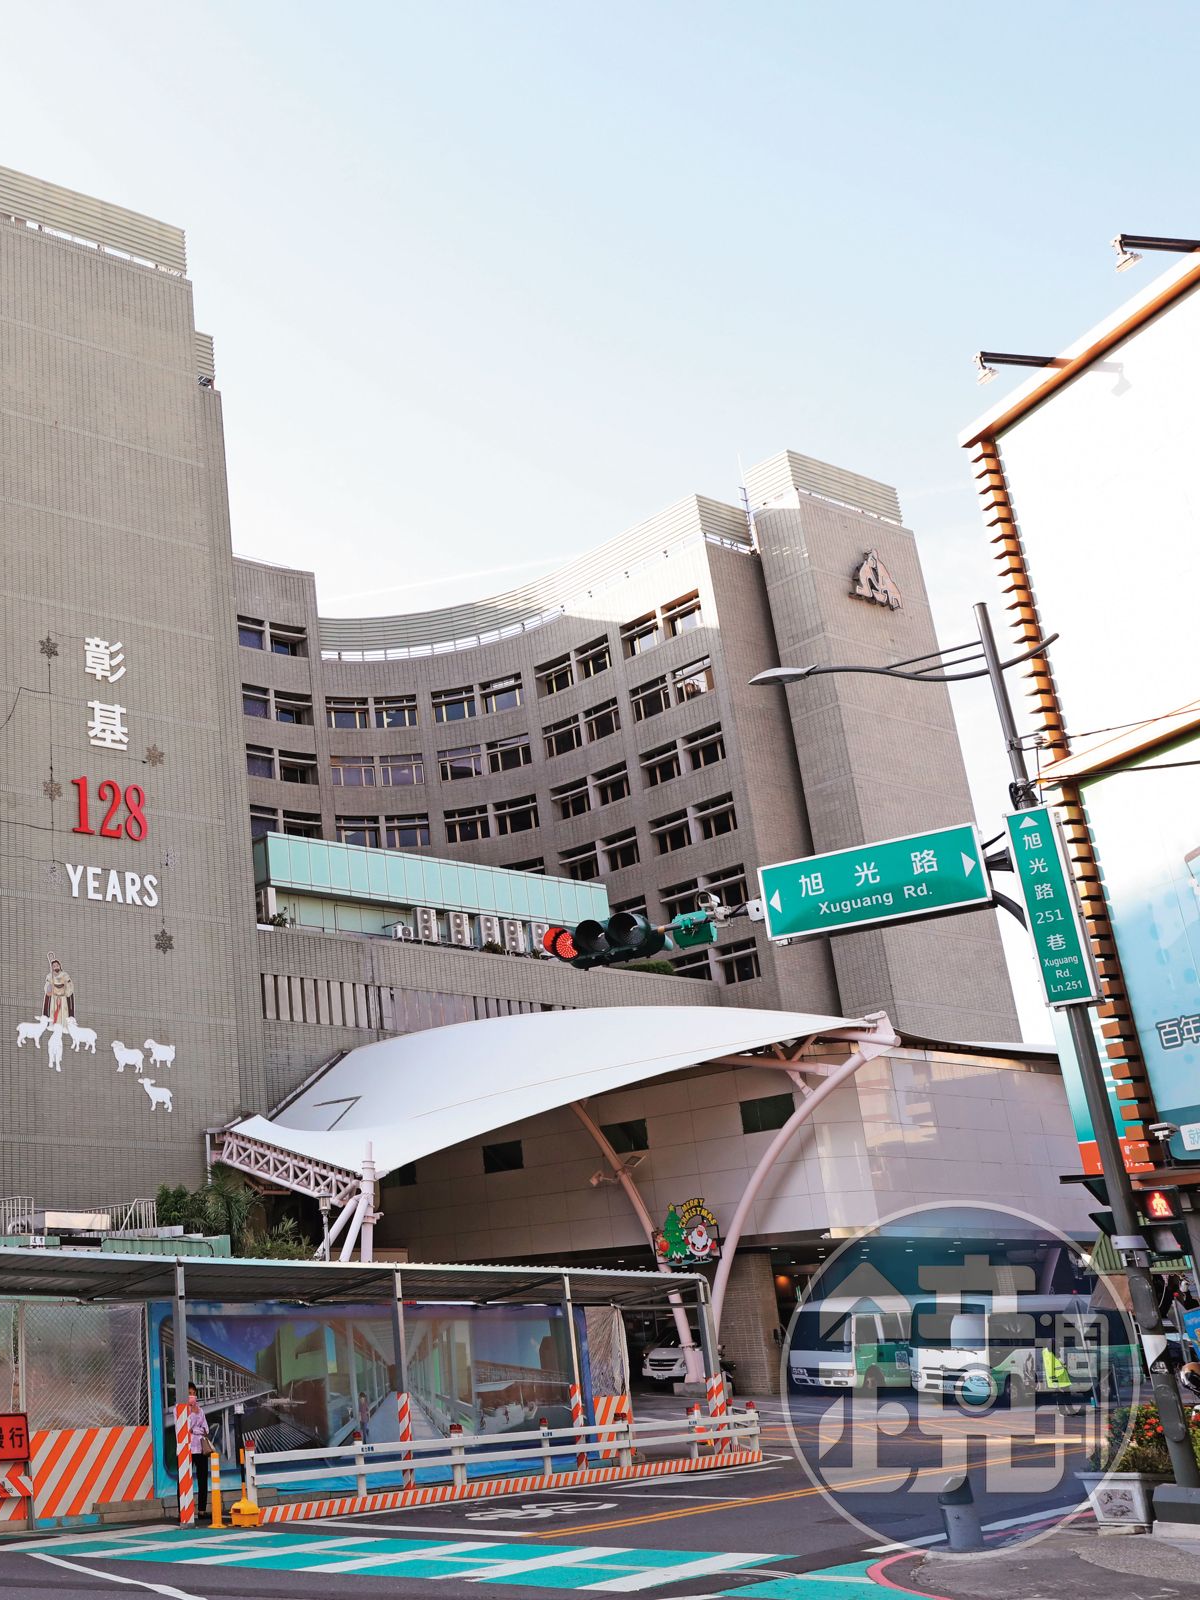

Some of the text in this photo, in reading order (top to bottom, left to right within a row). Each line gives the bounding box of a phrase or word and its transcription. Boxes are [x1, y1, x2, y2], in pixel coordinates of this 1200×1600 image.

[84, 636, 129, 751] 彰基
[71, 775, 148, 841] 128
[65, 863, 159, 907] YEARS
[799, 849, 938, 897] 旭光路
[818, 883, 933, 916] Xuguang Rd.
[1044, 954, 1079, 968] Xuguang
[1056, 968, 1073, 979] Rd.
[1051, 980, 1083, 993] Ln.251
